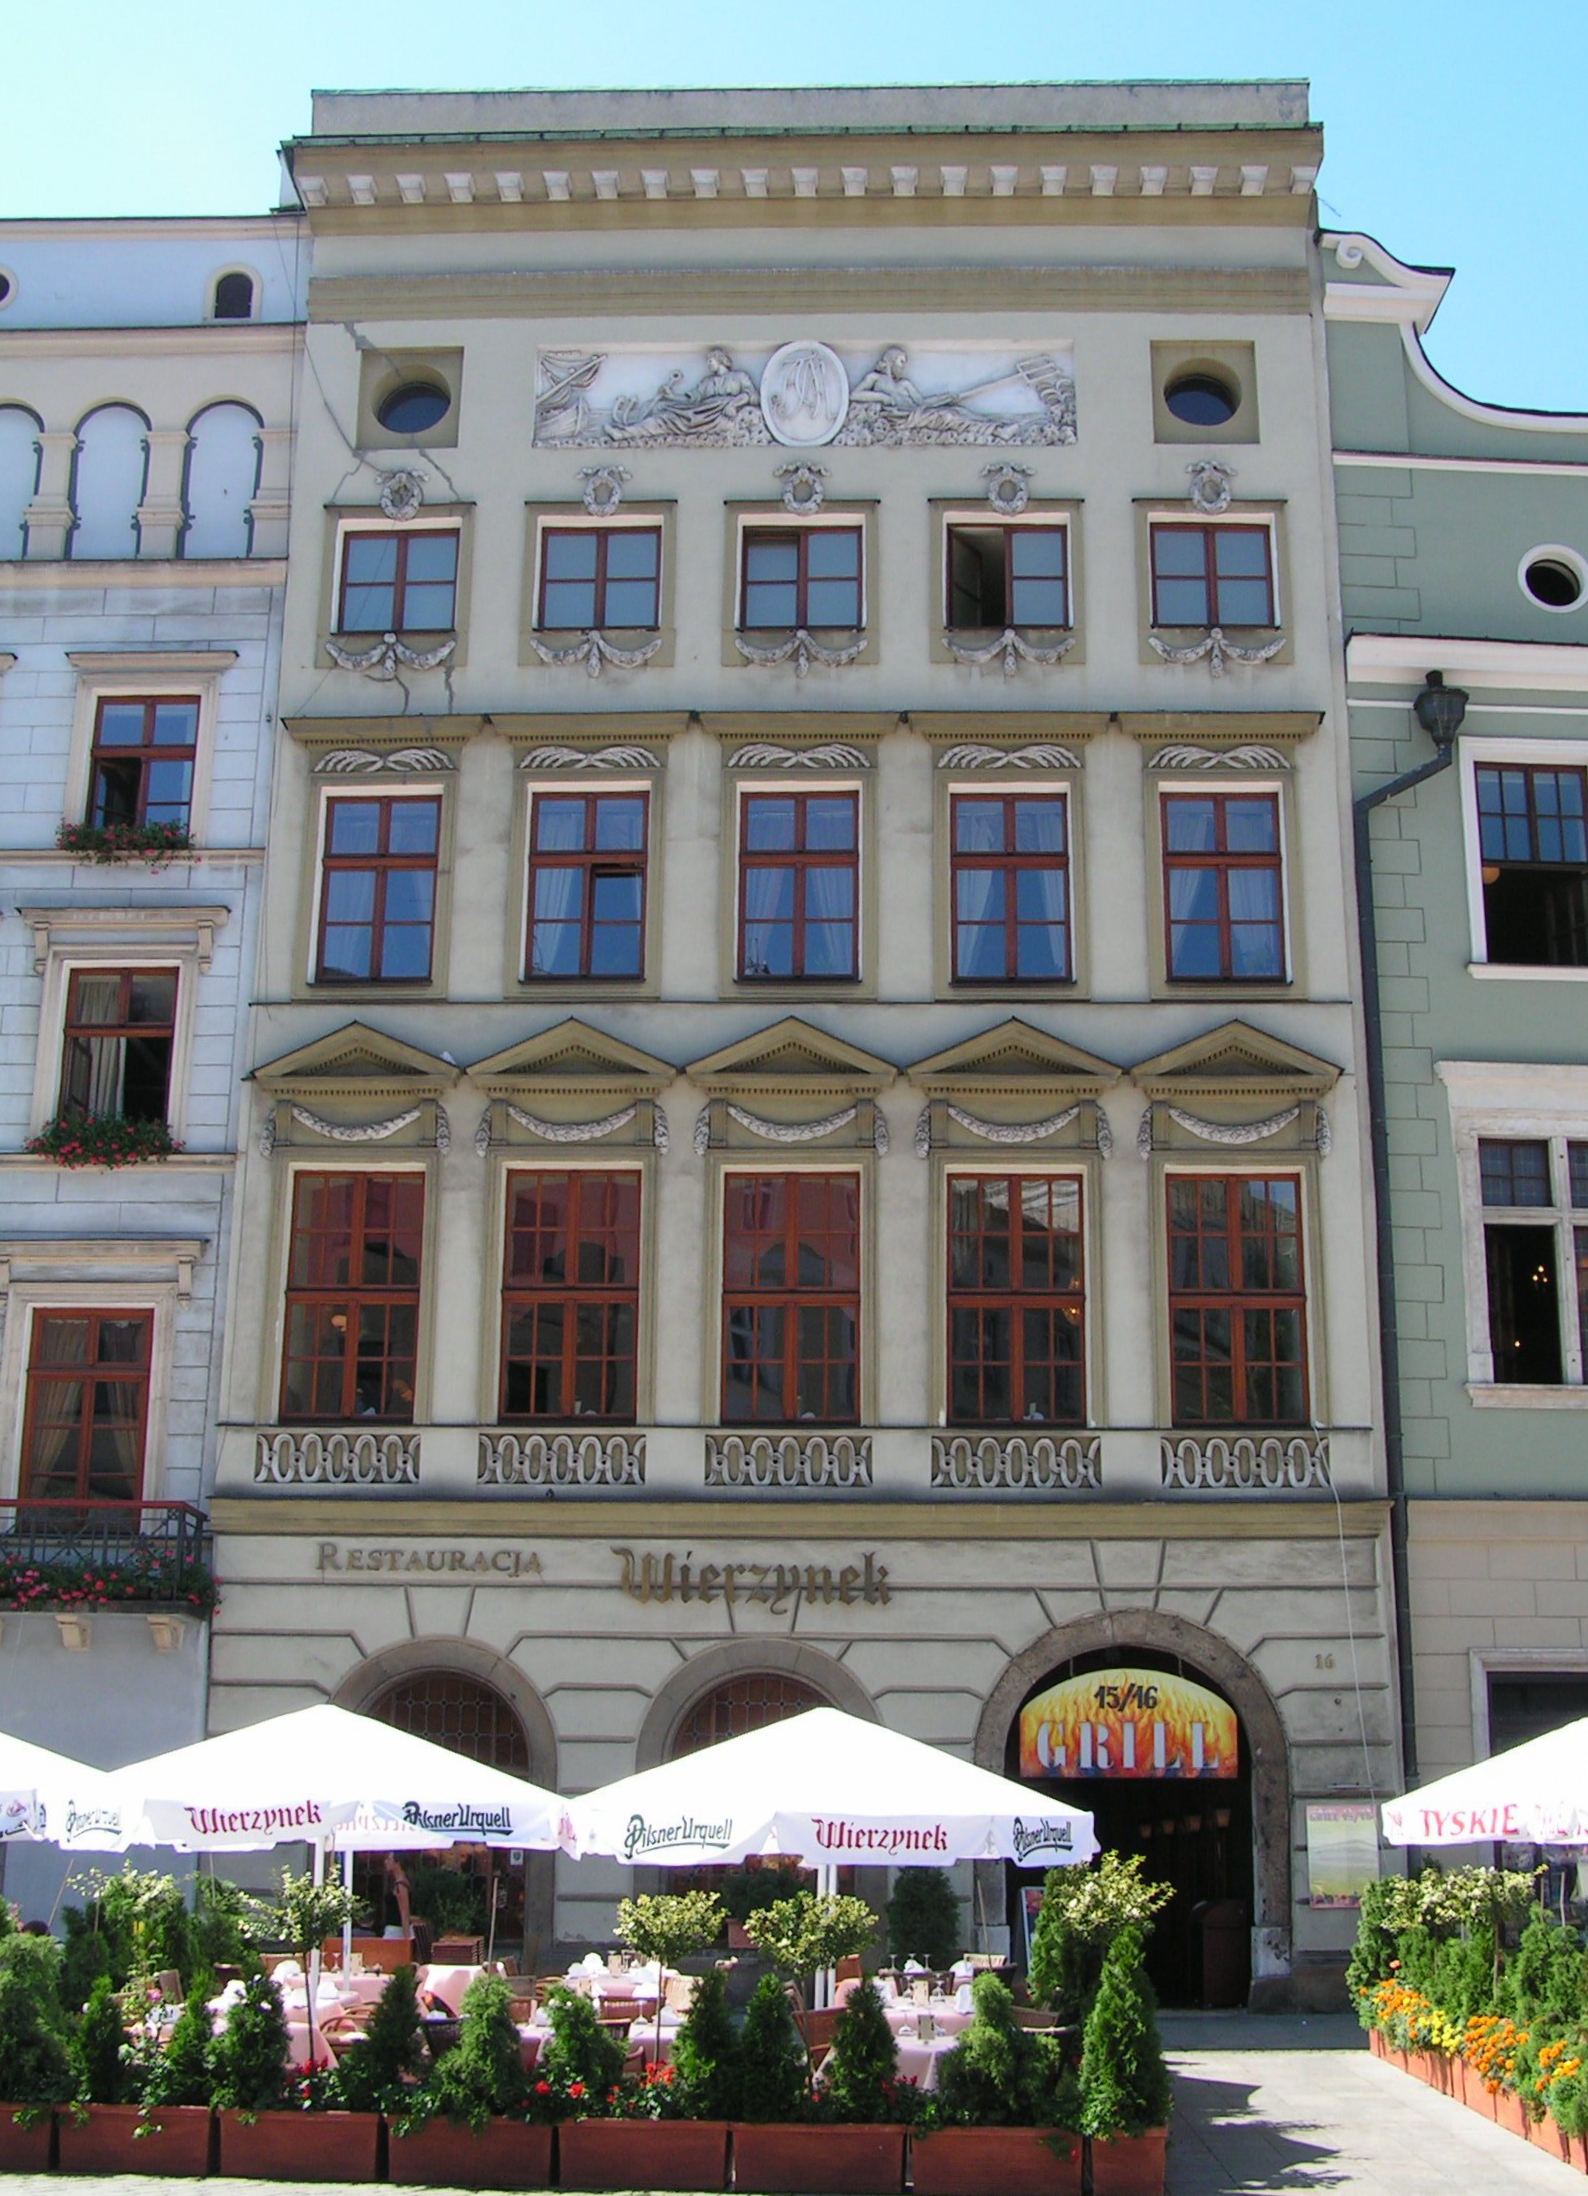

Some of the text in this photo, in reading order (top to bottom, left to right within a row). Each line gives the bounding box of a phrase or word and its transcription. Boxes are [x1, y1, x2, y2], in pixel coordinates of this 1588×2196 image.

[316, 1542, 893, 1615] RESTAURACJA Wierzynek
[1315, 1653, 1333, 1670] 16
[1094, 1683, 1158, 1712] 15/16
[1037, 1721, 1219, 1769] GRILL
[184, 1800, 322, 1835] Wierzynek
[403, 1801, 511, 1836] Pilsner Urquell
[1420, 1803, 1520, 1837] TYSKIE
[624, 1814, 683, 1859] Pilsner
[682, 1815, 732, 1849] Urquell
[811, 1818, 948, 1856] Wierzynek
